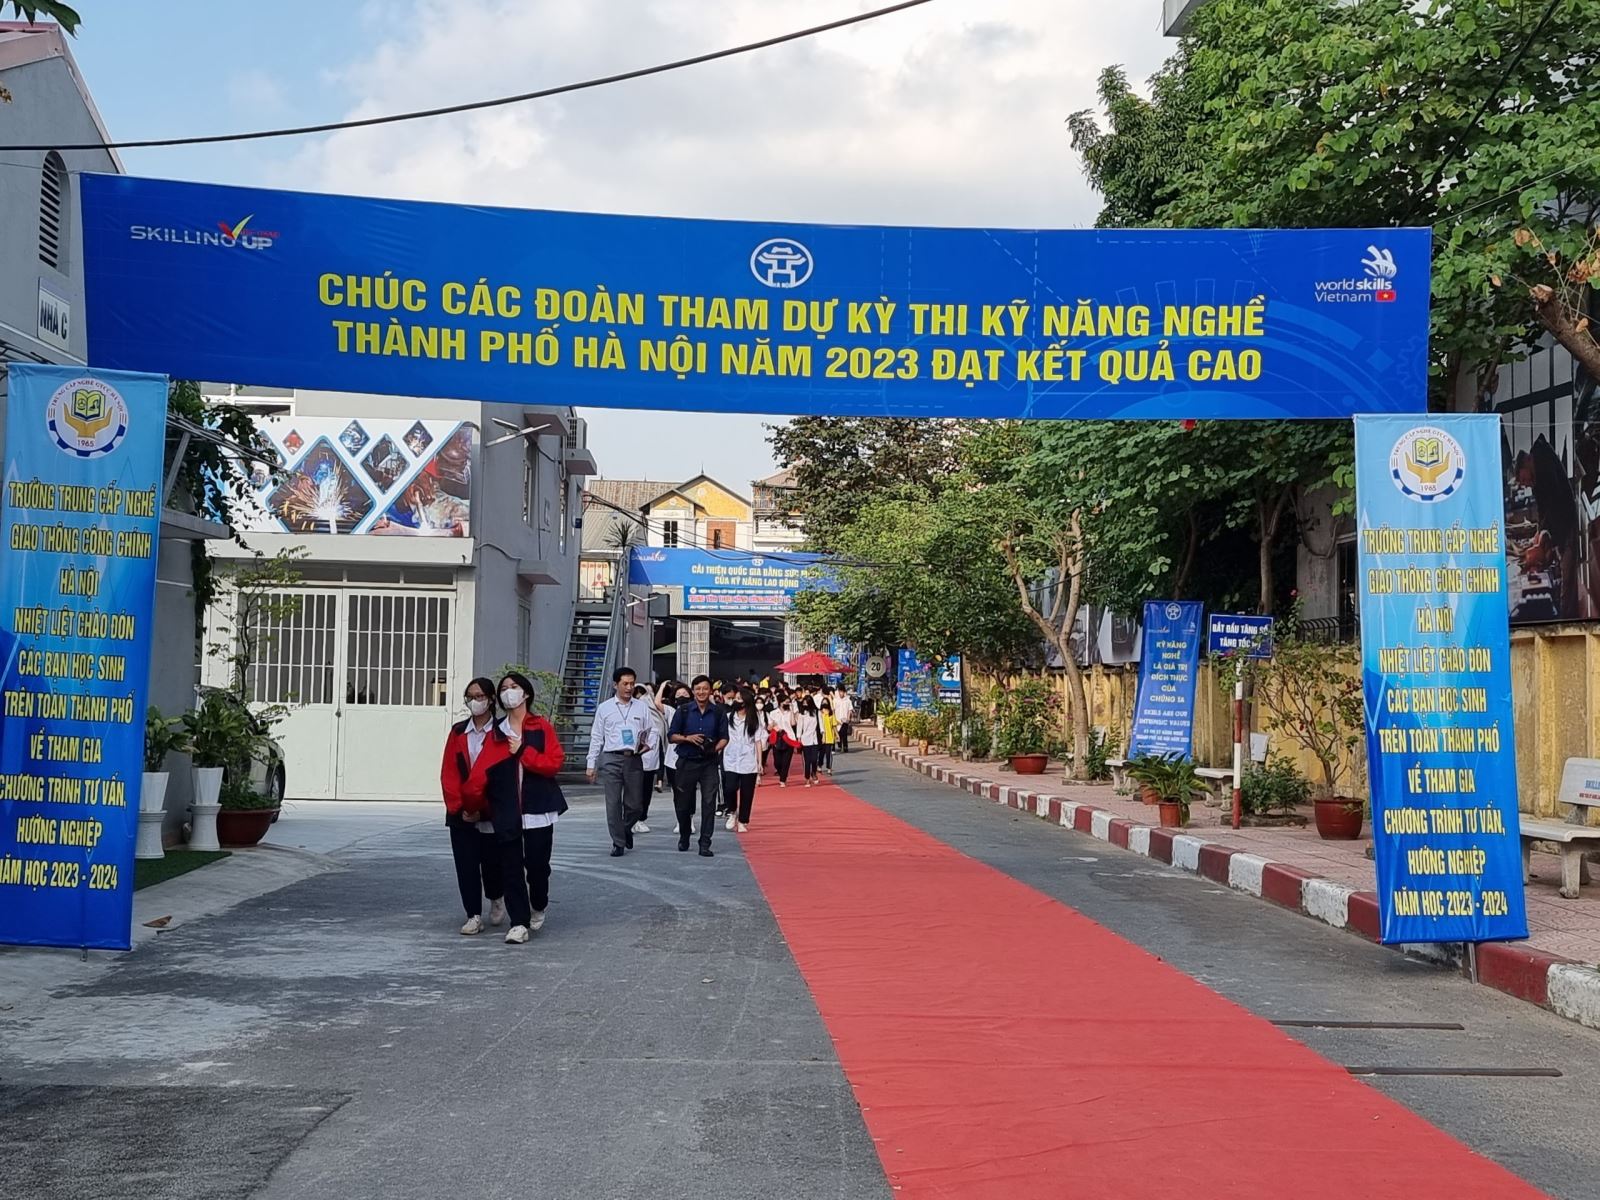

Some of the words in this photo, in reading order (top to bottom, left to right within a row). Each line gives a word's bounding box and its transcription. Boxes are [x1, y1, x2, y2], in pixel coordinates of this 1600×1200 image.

[242, 236, 273, 250] UP
[319, 272, 427, 312] CHÚC
[443, 279, 521, 317] CÁC
[535, 285, 643, 324] ĐOÀN
[659, 295, 767, 331] THAM
[784, 298, 838, 340] DỰ
[848, 295, 895, 335] KỲ
[910, 304, 966, 336] THI
[981, 300, 1030, 337] KỸ
[1044, 299, 1150, 337] NĂNG
[1164, 295, 1266, 337] NGHỀ
[1314, 291, 1372, 303] Vietnam
[40, 299, 58, 336] NHÀ
[61, 312, 68, 340] C
[332, 319, 466, 361] THÀNH
[480, 324, 561, 366] PHỐ
[574, 331, 625, 370] HÀ
[639, 335, 706, 380] NỘI
[720, 340, 812, 377] NĂM
[826, 348, 919, 380] 2023
[931, 349, 1003, 387] ĐẠT
[1017, 339, 1087, 380] KẾT
[1099, 339, 1175, 385] QUẢ
[1188, 350, 1262, 381] CAO
[78, 440, 94, 448] 1965
[9, 477, 56, 510] TRƯỜNG
[58, 485, 96, 514] TRUNG
[99, 480, 122, 515] CẤP
[124, 483, 157, 518] NGHỀ
[1420, 484, 1436, 492] 1965
[11, 523, 38, 552] GIAO
[42, 521, 79, 554] THÔNG
[82, 524, 113, 557] CÔNG
[116, 527, 152, 559] CHÍNH
[1407, 528, 1442, 554] TRUNG
[1445, 520, 1466, 554] CẤP
[60, 563, 76, 596] HÀ
[78, 567, 99, 602] NỘI
[749, 568, 762, 576] GIA
[764, 578, 778, 587] LAO
[1368, 568, 1394, 594] GIAO
[1396, 562, 1432, 594] THÔNG
[1435, 562, 1463, 594] CÔNG
[1466, 562, 1499, 593] CHÍNH
[14, 603, 48, 641] NHIỆT
[50, 605, 75, 642] LIỆT
[77, 605, 108, 639] CHÀO
[110, 608, 136, 640] ĐÓN
[1416, 602, 1434, 633] HÀ
[1436, 604, 1454, 638] NỘI
[18, 646, 42, 676] CÁC
[44, 652, 68, 681] BẠN
[71, 653, 94, 684] HỌC
[97, 654, 125, 682] SINH
[870, 662, 881, 672] 20
[1380, 644, 1412, 678] NHIỆT
[1413, 644, 1436, 678] LIỆT
[1438, 644, 1466, 672] CHÀO
[1469, 644, 1492, 672] ĐÓN
[4, 686, 34, 718] TRÊN
[37, 688, 67, 720] TOÀN
[70, 690, 108, 722] THÀNH
[110, 689, 136, 724] PHỐ
[1387, 683, 1410, 714] CÁC
[1412, 688, 1436, 719] BẠN
[1438, 688, 1460, 718] HỌC
[1461, 687, 1488, 712] SINH
[30, 726, 46, 760] VỀ
[47, 736, 80, 763] THAM
[82, 736, 102, 764] GIA
[1378, 724, 1408, 754] TRÊN
[1408, 723, 1439, 753] TOÀN
[1441, 723, 1476, 752] THÀNH
[1477, 719, 1500, 753] PHỐ
[0, 773, 44, 802] CHƯƠNG
[48, 773, 82, 804] TRÌNH
[84, 778, 100, 806] TƯ
[1408, 762, 1422, 794] VỀ
[1424, 768, 1456, 793] THAM
[1458, 768, 1476, 793] GIA
[16, 813, 58, 845] HƯỚNG
[60, 815, 102, 852] NGHIỆP
[1384, 806, 1428, 834] CHƯƠNG
[1430, 803, 1462, 834] TRÌNH
[1464, 808, 1479, 834] TƯ
[24, 859, 48, 892] HỌC
[50, 862, 80, 888] 2023
[88, 864, 118, 890] 2024
[1408, 844, 1446, 875] HƯỚNG
[1448, 844, 1486, 880] NGHIỆP
[1394, 886, 1420, 916] NĂM
[1421, 890, 1444, 922] HỌC
[1446, 890, 1473, 916] 2023
[1482, 890, 1508, 916] 2024
